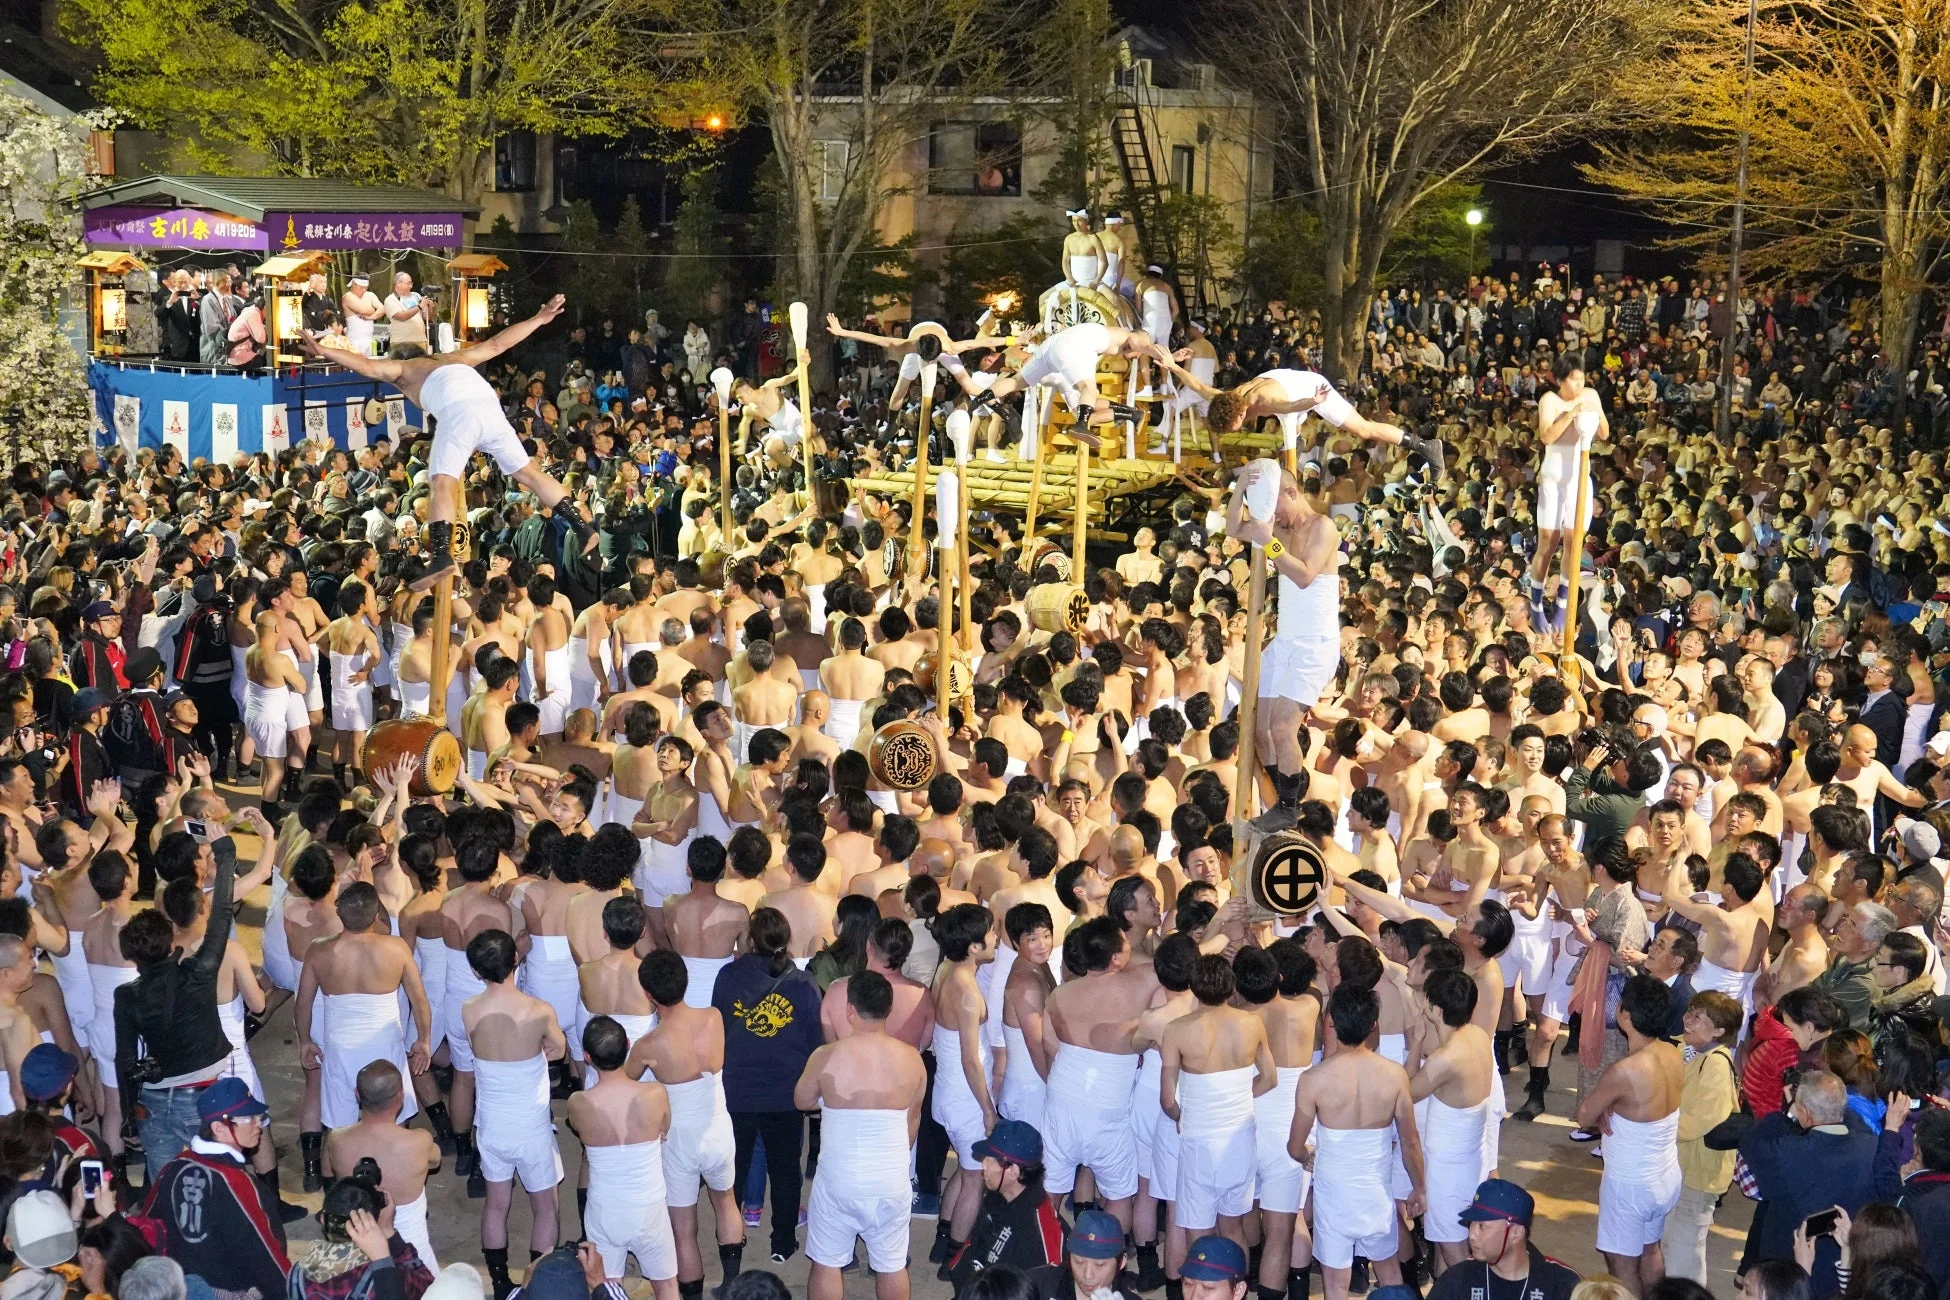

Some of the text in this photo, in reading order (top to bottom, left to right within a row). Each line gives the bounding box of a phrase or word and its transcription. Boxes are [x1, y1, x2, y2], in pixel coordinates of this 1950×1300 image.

[149, 216, 210, 240] 古川祭
[181, 1169, 207, 1235] 古川
